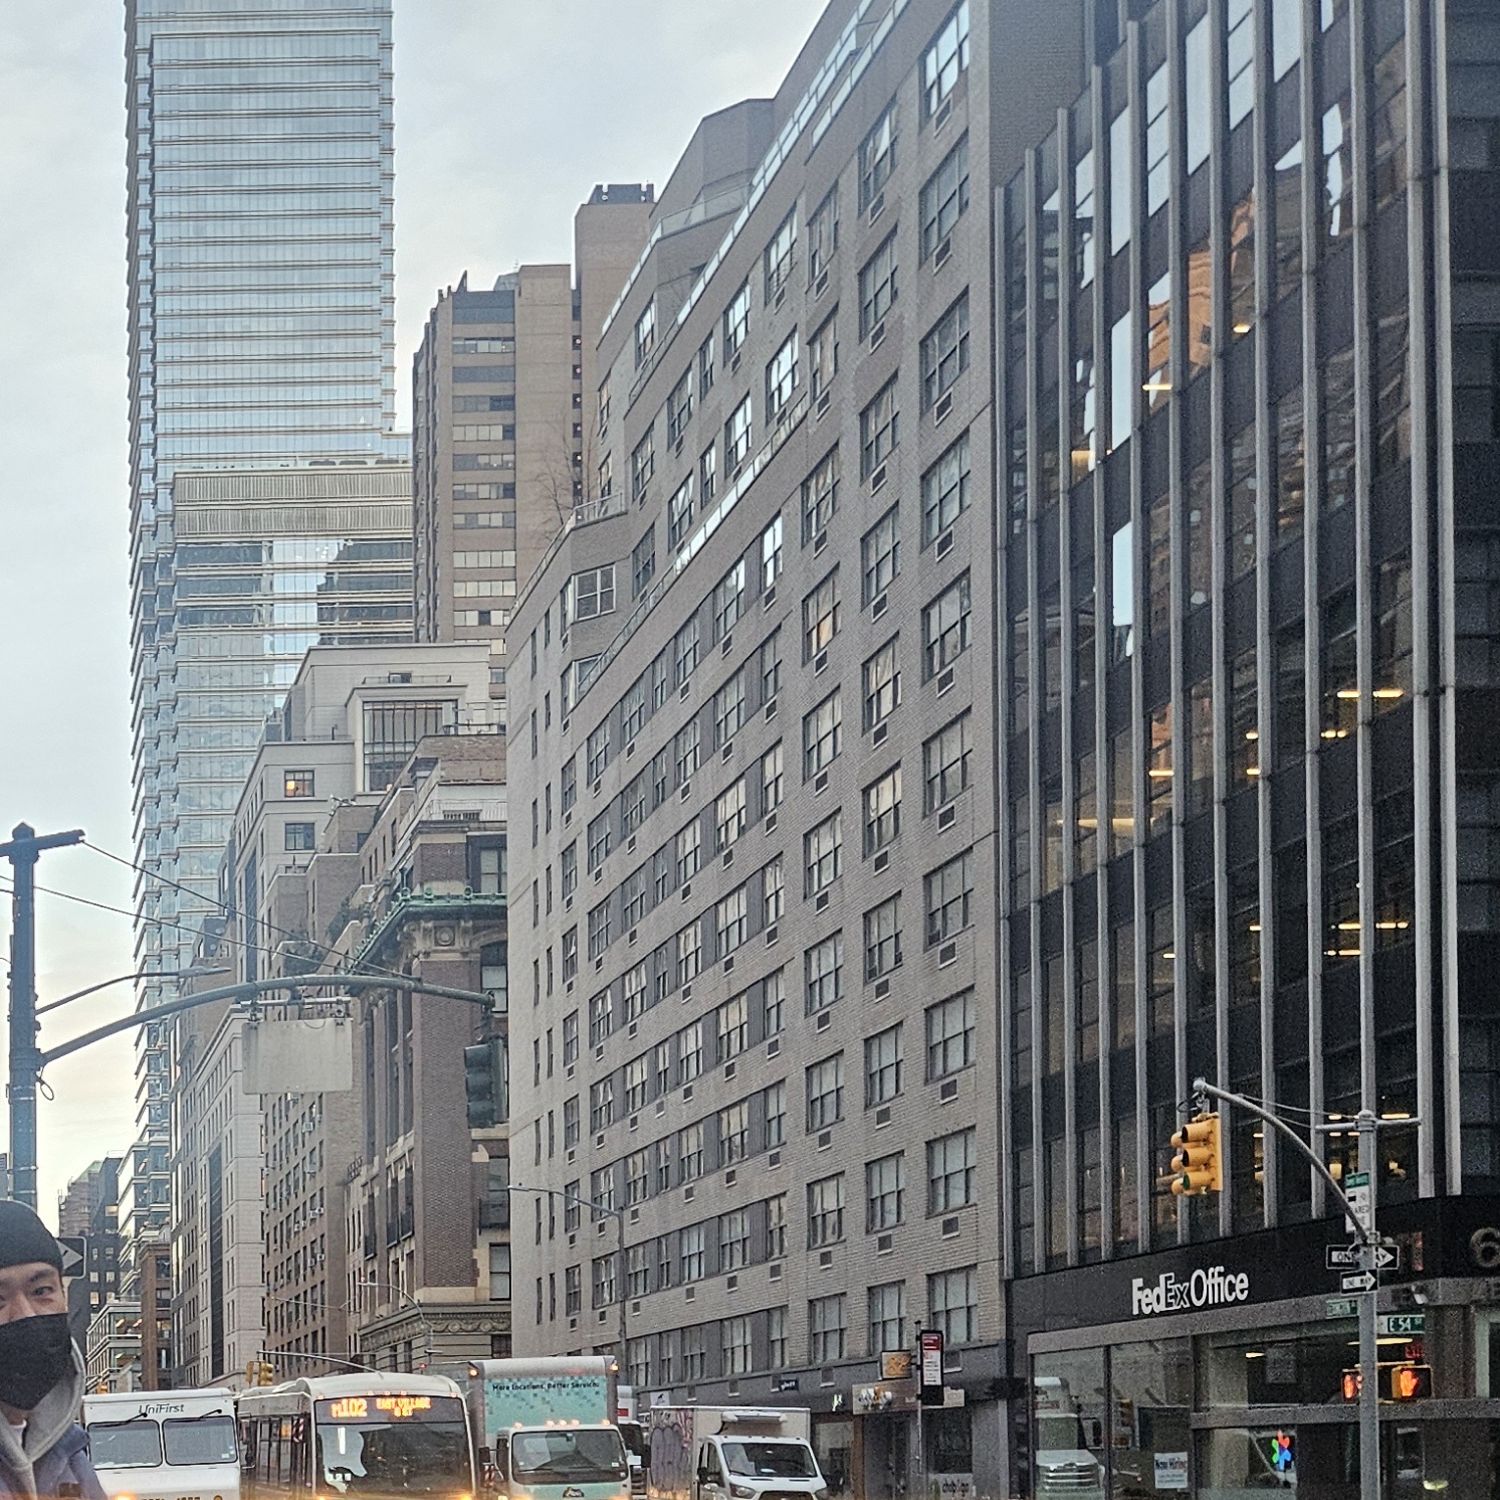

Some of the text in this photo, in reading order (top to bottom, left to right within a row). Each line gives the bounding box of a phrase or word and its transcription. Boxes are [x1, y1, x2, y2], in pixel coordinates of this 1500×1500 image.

[1132, 1266, 1249, 1316] FedEx Office
[1389, 1317, 1396, 1331] E
[1399, 1317, 1411, 1331] 54
[492, 1384, 510, 1392] More
[547, 1382, 570, 1390] Better
[138, 1403, 185, 1415] UniFirst
[331, 1398, 368, 1418] M102
